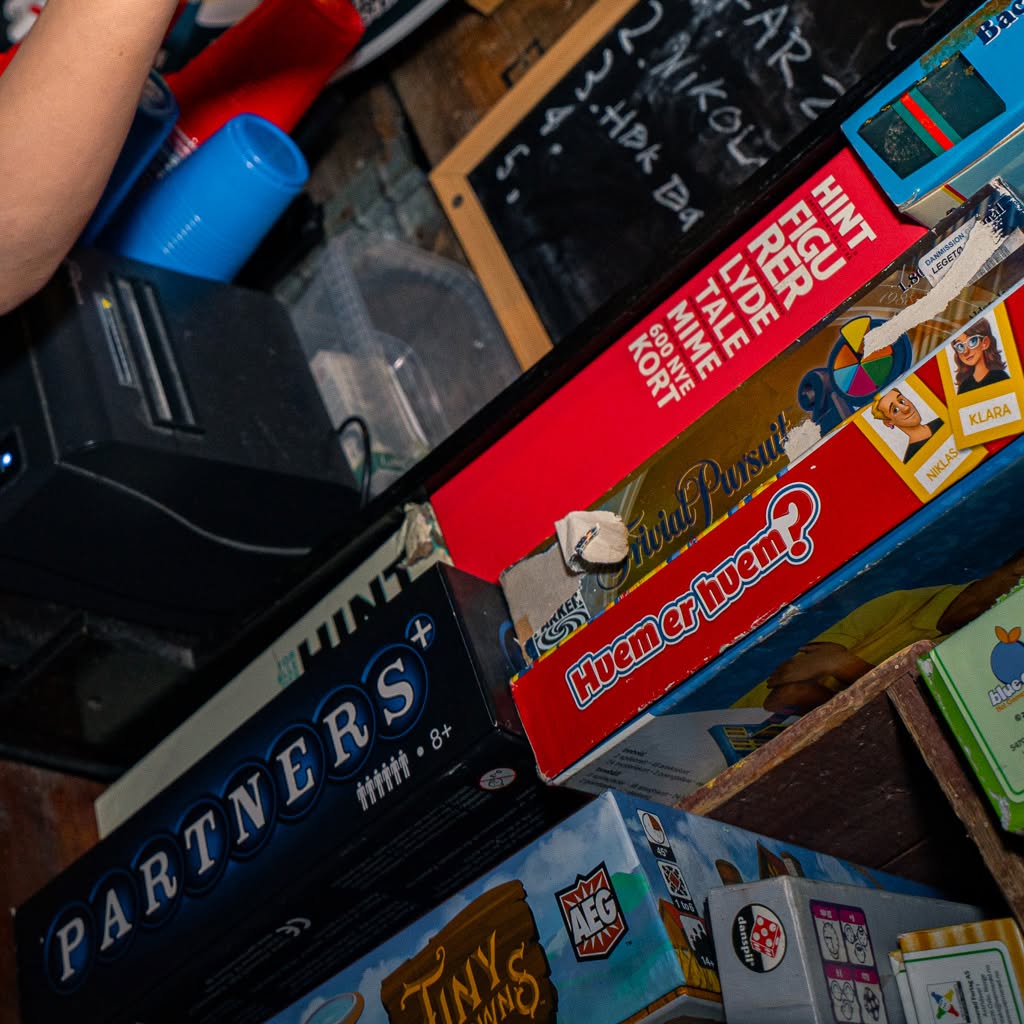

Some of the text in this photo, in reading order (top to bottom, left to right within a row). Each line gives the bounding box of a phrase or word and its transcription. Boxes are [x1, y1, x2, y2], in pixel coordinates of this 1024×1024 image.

[778, 199, 847, 281] FIGU
[810, 174, 877, 250] HINT
[747, 222, 814, 310] RER
[924, 232, 965, 267] DANMISSION
[931, 244, 965, 275] LEGETØ
[695, 277, 750, 358] TALE
[718, 253, 780, 335] LYDE
[628, 332, 682, 409] KORT
[649, 323, 674, 358] 600
[666, 356, 696, 396] NYE
[666, 299, 722, 381] MIME
[968, 403, 1012, 426] KLARA
[676, 411, 792, 529] Pursuit
[926, 447, 959, 482] NIKLAS
[661, 597, 698, 639] er
[429, 722, 454, 752] 8+
[569, 887, 618, 945] AEG
[736, 914, 755, 964] danspil
[400, 929, 501, 1024] TINY
